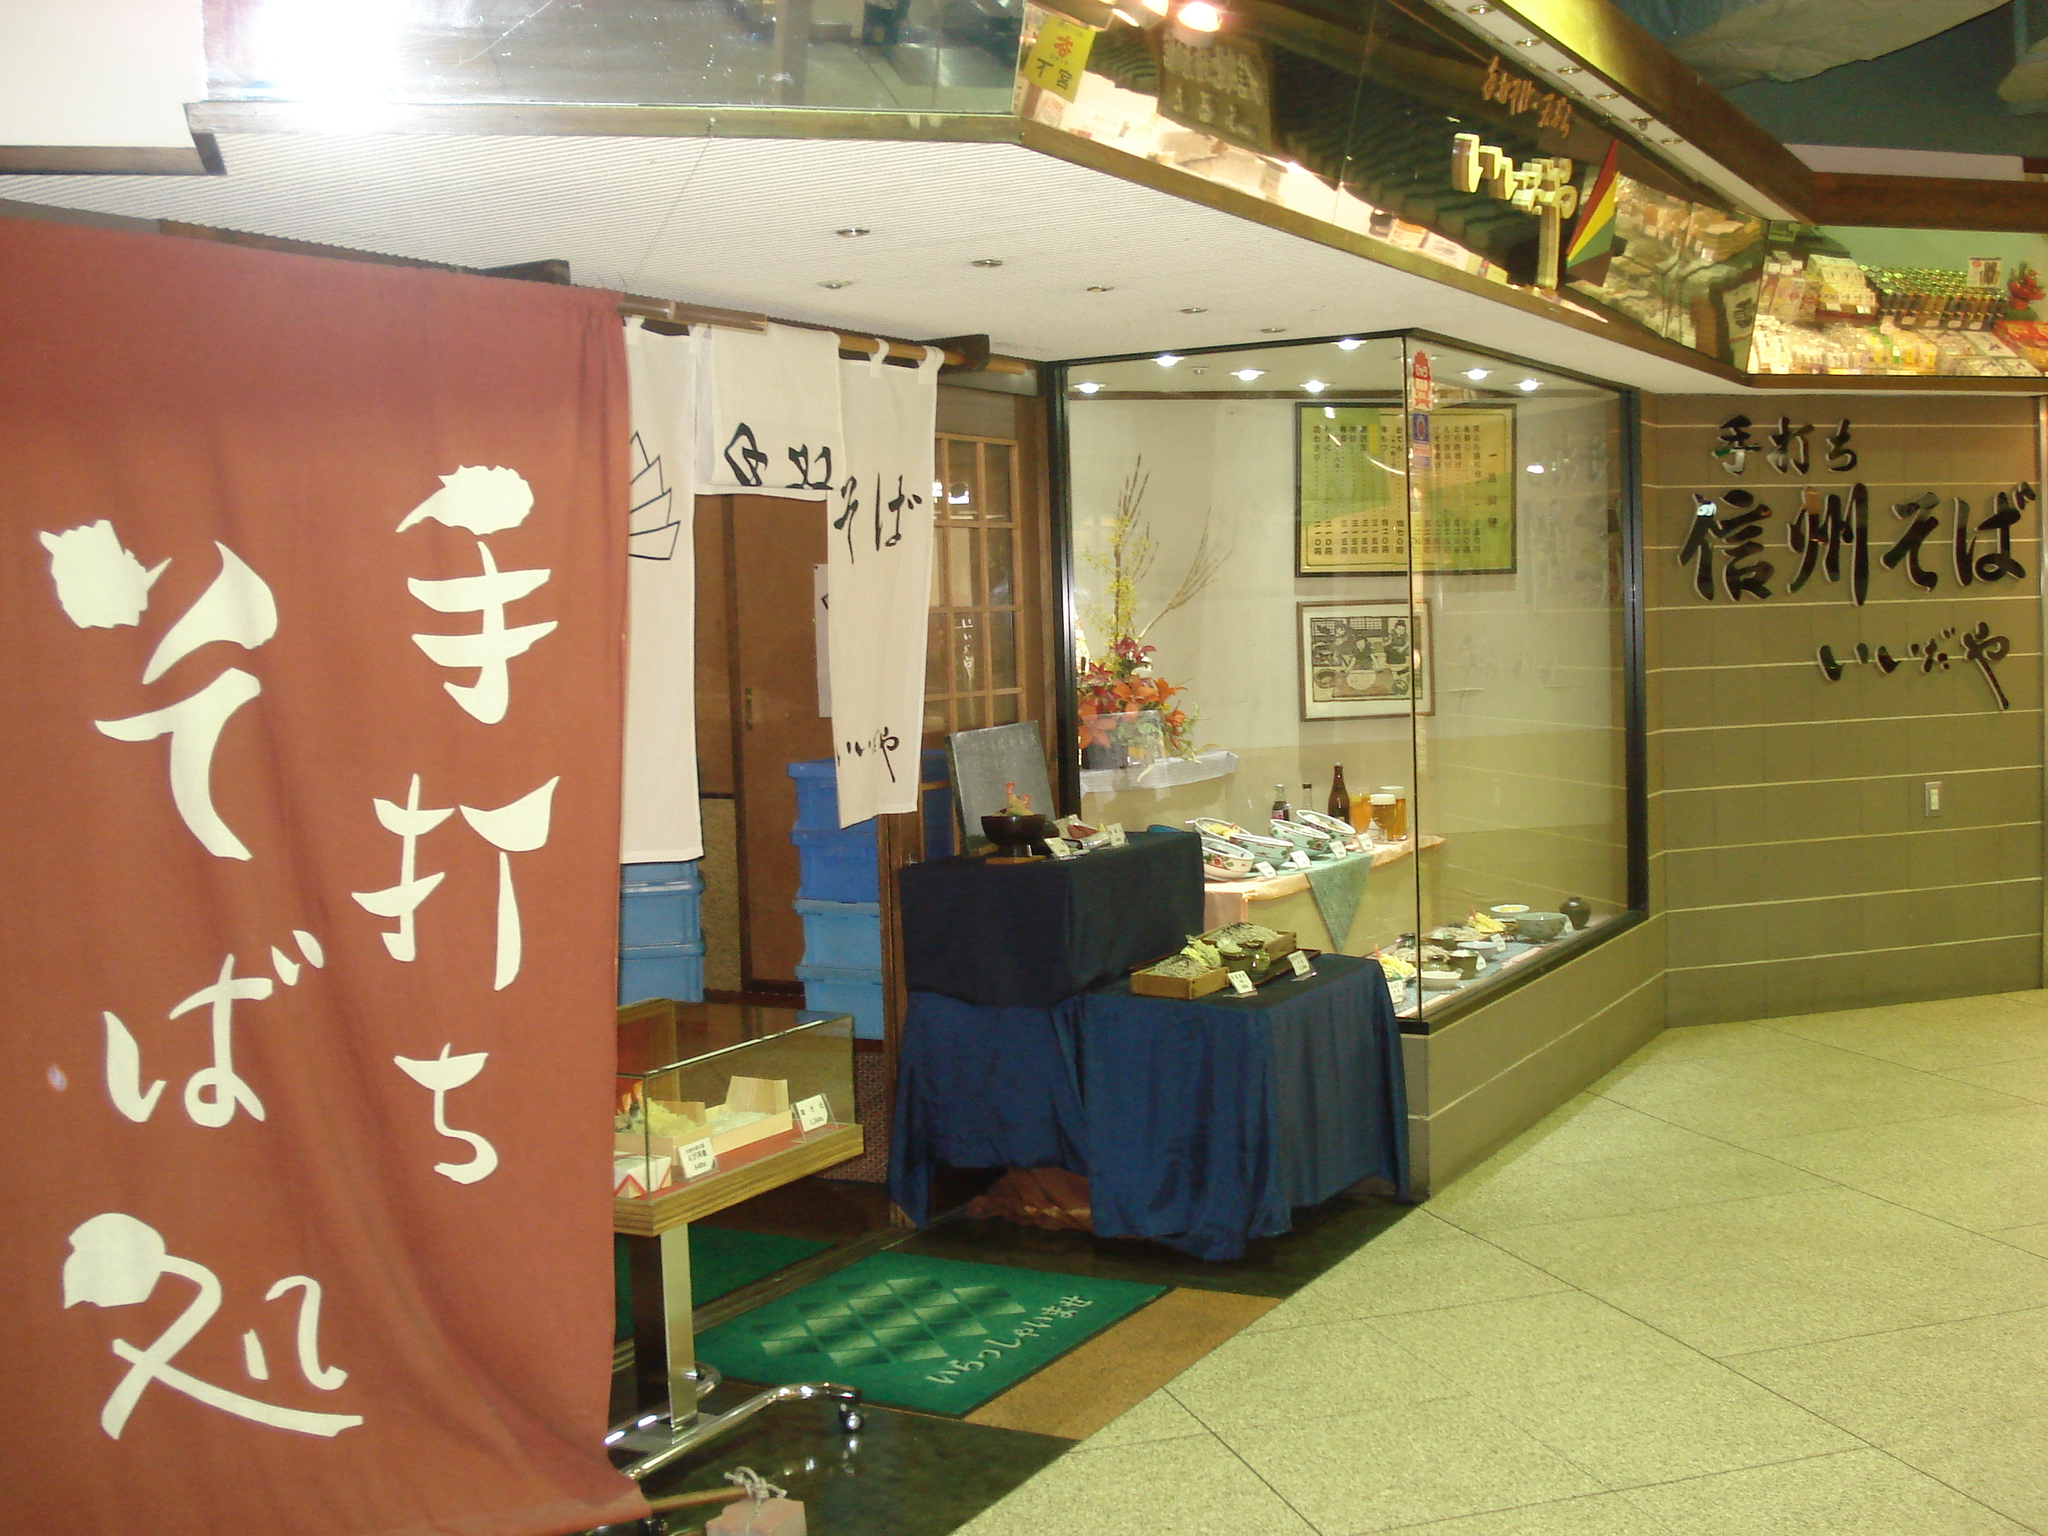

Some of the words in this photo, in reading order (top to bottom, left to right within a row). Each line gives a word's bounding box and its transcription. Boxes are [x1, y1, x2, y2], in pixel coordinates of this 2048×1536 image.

[1712, 414, 1858, 476] 手打ち
[834, 472, 922, 564] そば
[1677, 481, 2036, 606] 信州そば
[1817, 621, 2010, 711] いいだや
[351, 464, 559, 1186] 手打ち
[39, 519, 364, 1441] そば処
[926, 1296, 1094, 1384] いらっしゃいませ
